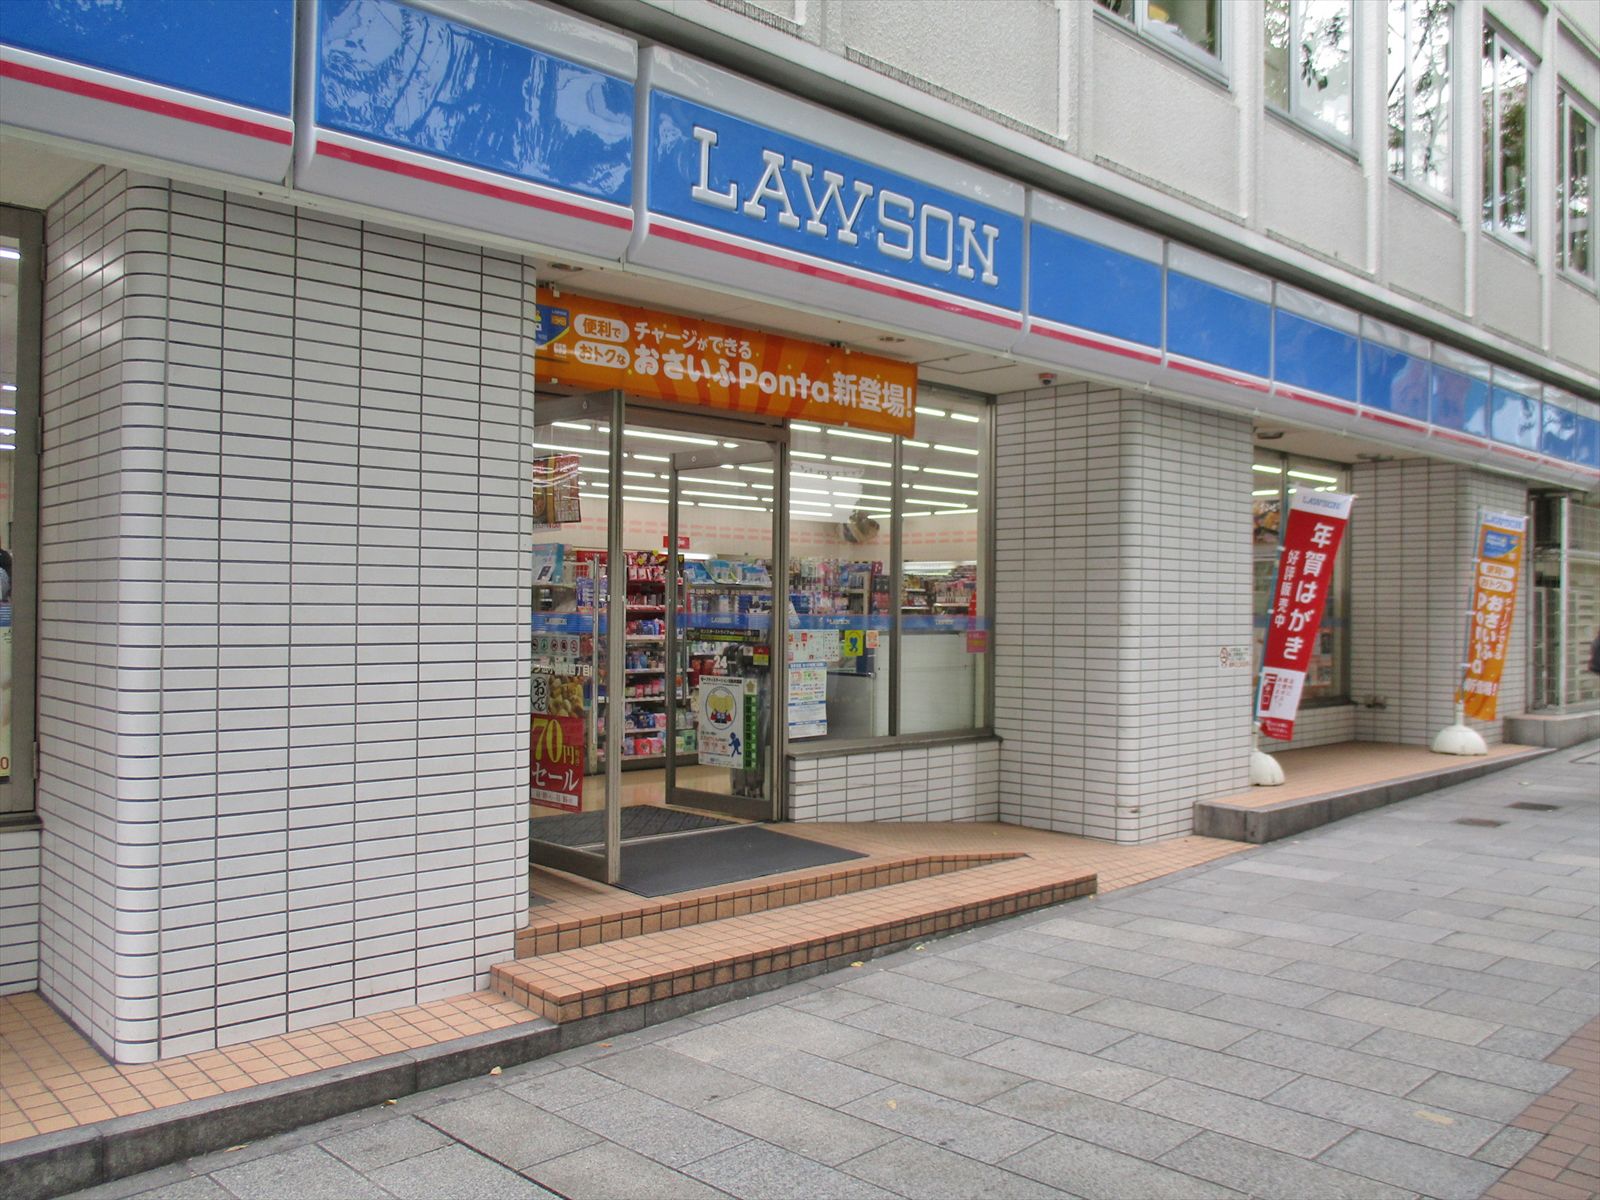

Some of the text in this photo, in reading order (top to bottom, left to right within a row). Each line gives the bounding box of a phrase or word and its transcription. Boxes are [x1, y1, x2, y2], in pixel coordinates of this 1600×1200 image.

[692, 126, 999, 287] LAWSON
[582, 317, 622, 338] 便利で
[634, 321, 753, 360] チャージができる
[578, 343, 627, 367] おトクな
[1274, 550, 1301, 628] 好評販売中
[1283, 522, 1335, 660] 年賀はがき
[713, 655, 727, 668] 24
[531, 762, 579, 792] セール
